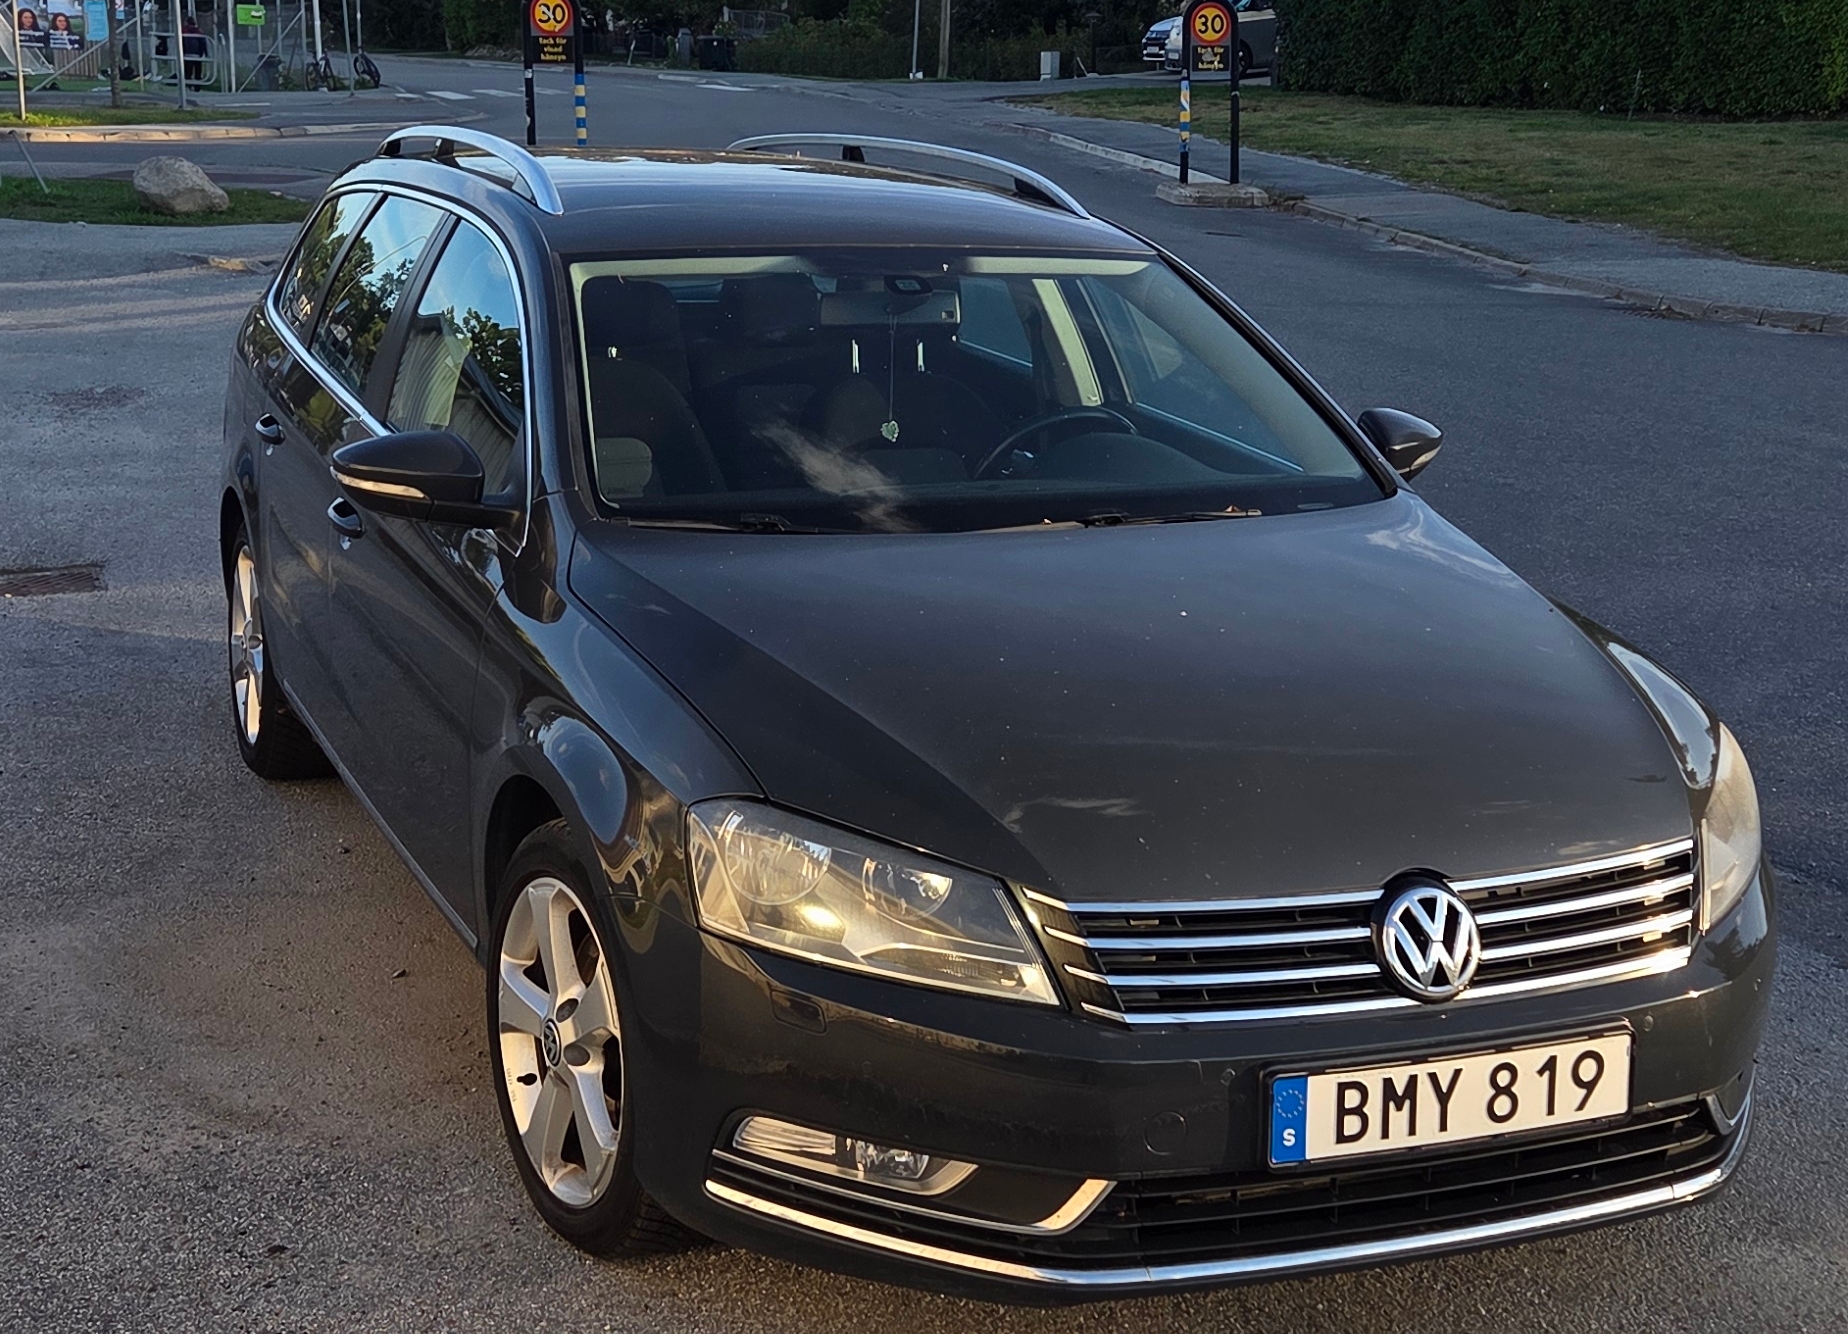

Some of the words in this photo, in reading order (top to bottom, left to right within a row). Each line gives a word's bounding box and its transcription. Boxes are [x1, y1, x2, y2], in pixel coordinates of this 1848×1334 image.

[538, 3, 566, 24] 30
[1198, 14, 1224, 34] 30
[1383, 886, 1481, 994] VW
[1335, 1068, 1463, 1145] BMY
[1486, 1049, 1605, 1124] 819
[1282, 1128, 1296, 1147] S
